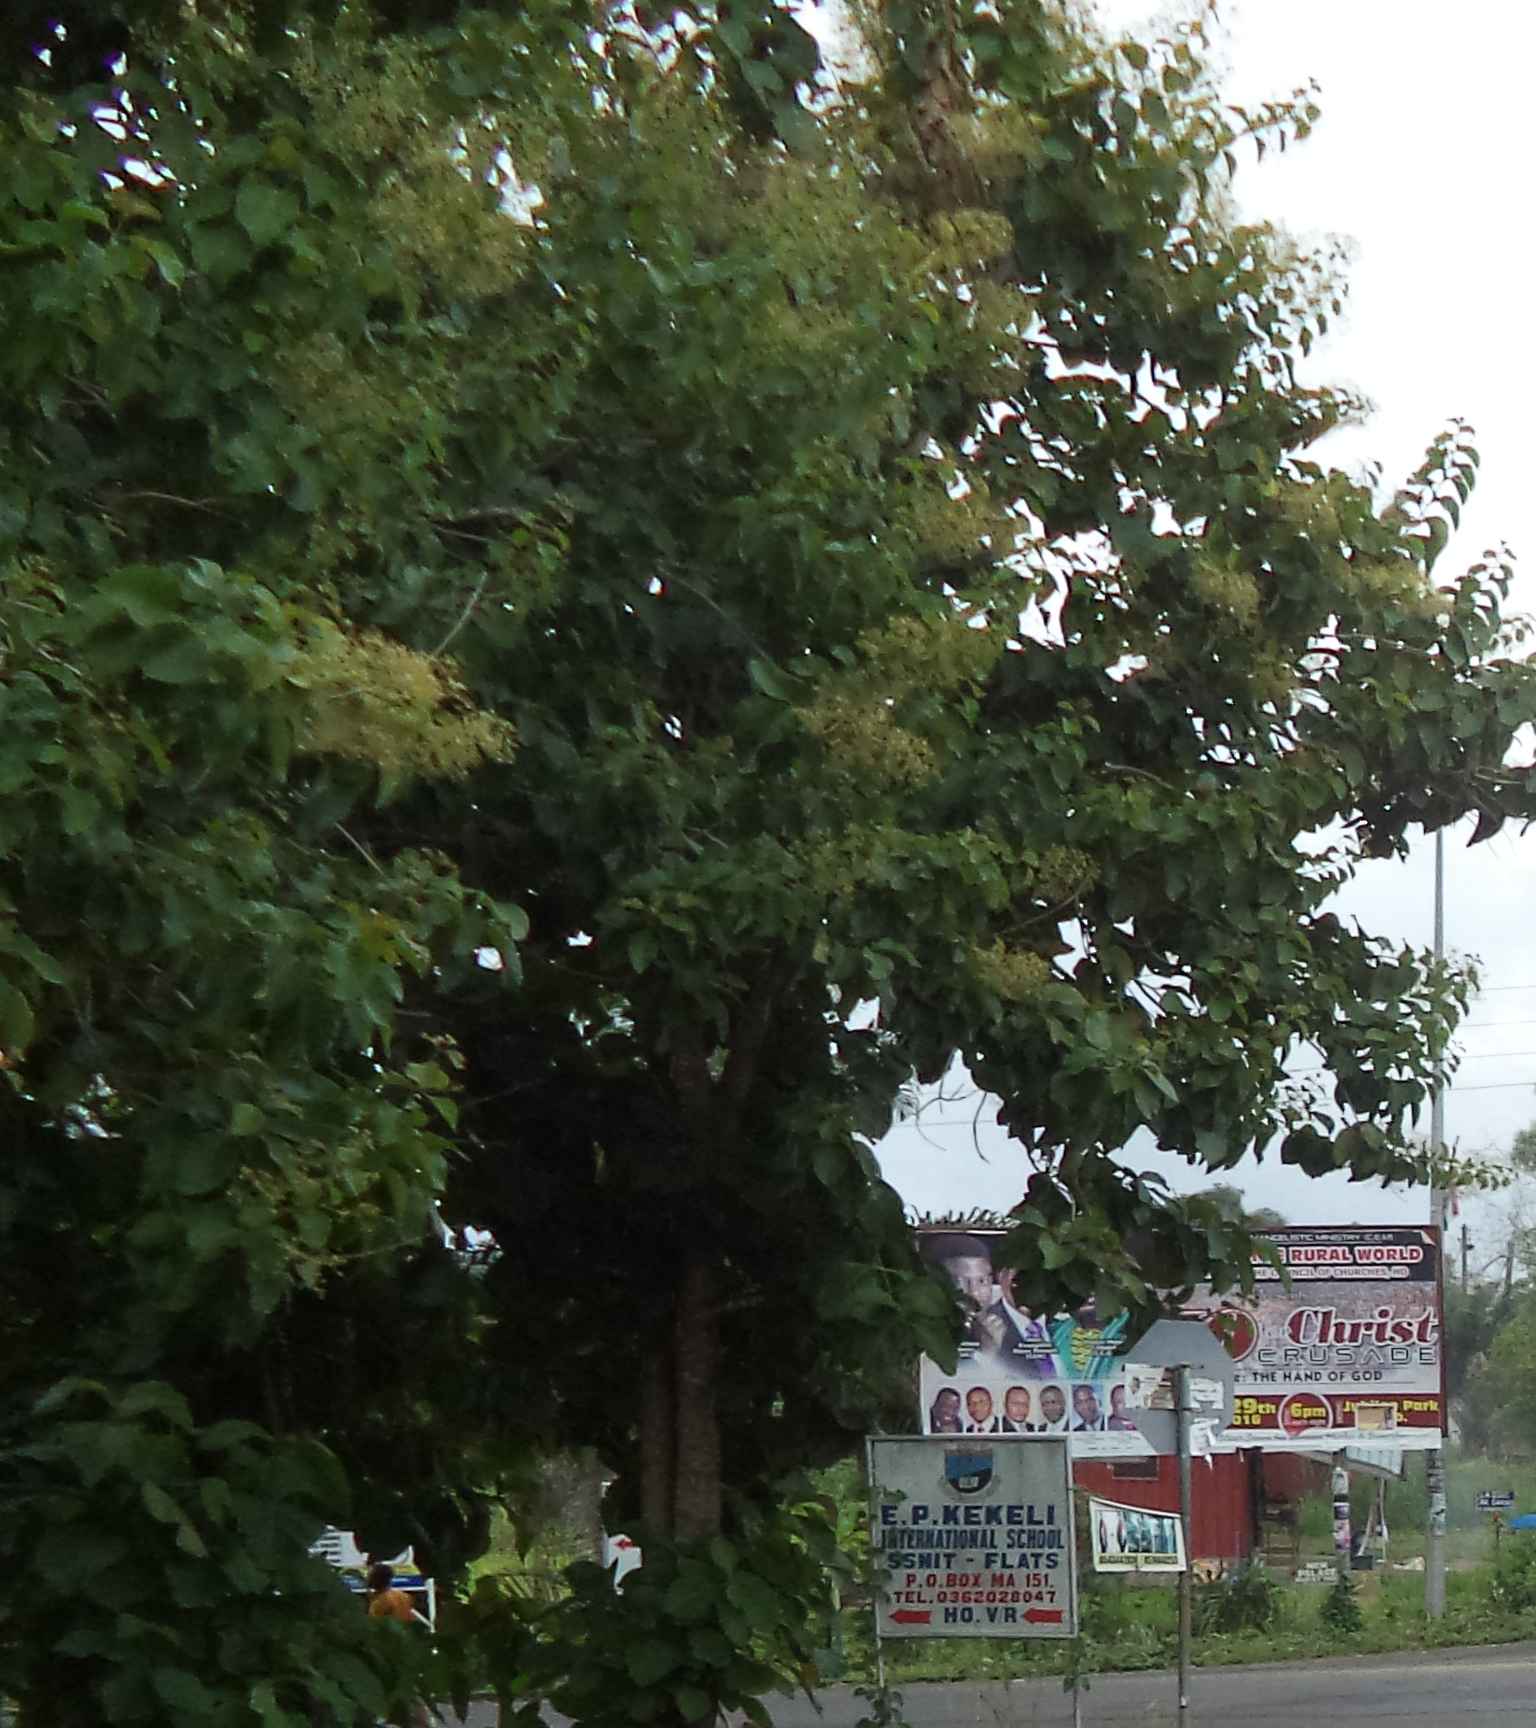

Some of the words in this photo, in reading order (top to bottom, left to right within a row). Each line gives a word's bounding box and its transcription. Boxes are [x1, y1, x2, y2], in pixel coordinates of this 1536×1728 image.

[1291, 1248, 1351, 1261] RURAL
[1356, 1248, 1421, 1261] WORLD
[1286, 1306, 1438, 1346] Christ
[1258, 1347, 1436, 1366] CRUSADE
[1253, 1371, 1277, 1382] THE
[1283, 1371, 1321, 1382] HAND
[1328, 1371, 1346, 1381] OF
[1352, 1371, 1383, 1381] GOD
[1290, 1402, 1327, 1420] 6pm
[1402, 1400, 1439, 1412] Park
[881, 1528, 997, 1549] INTERNATIONAL
[1007, 1528, 1064, 1549] SCHOOL
[888, 1552, 957, 1569] SSNIT
[985, 1552, 1059, 1569] FLATS
[991, 1573, 1015, 1587] MA
